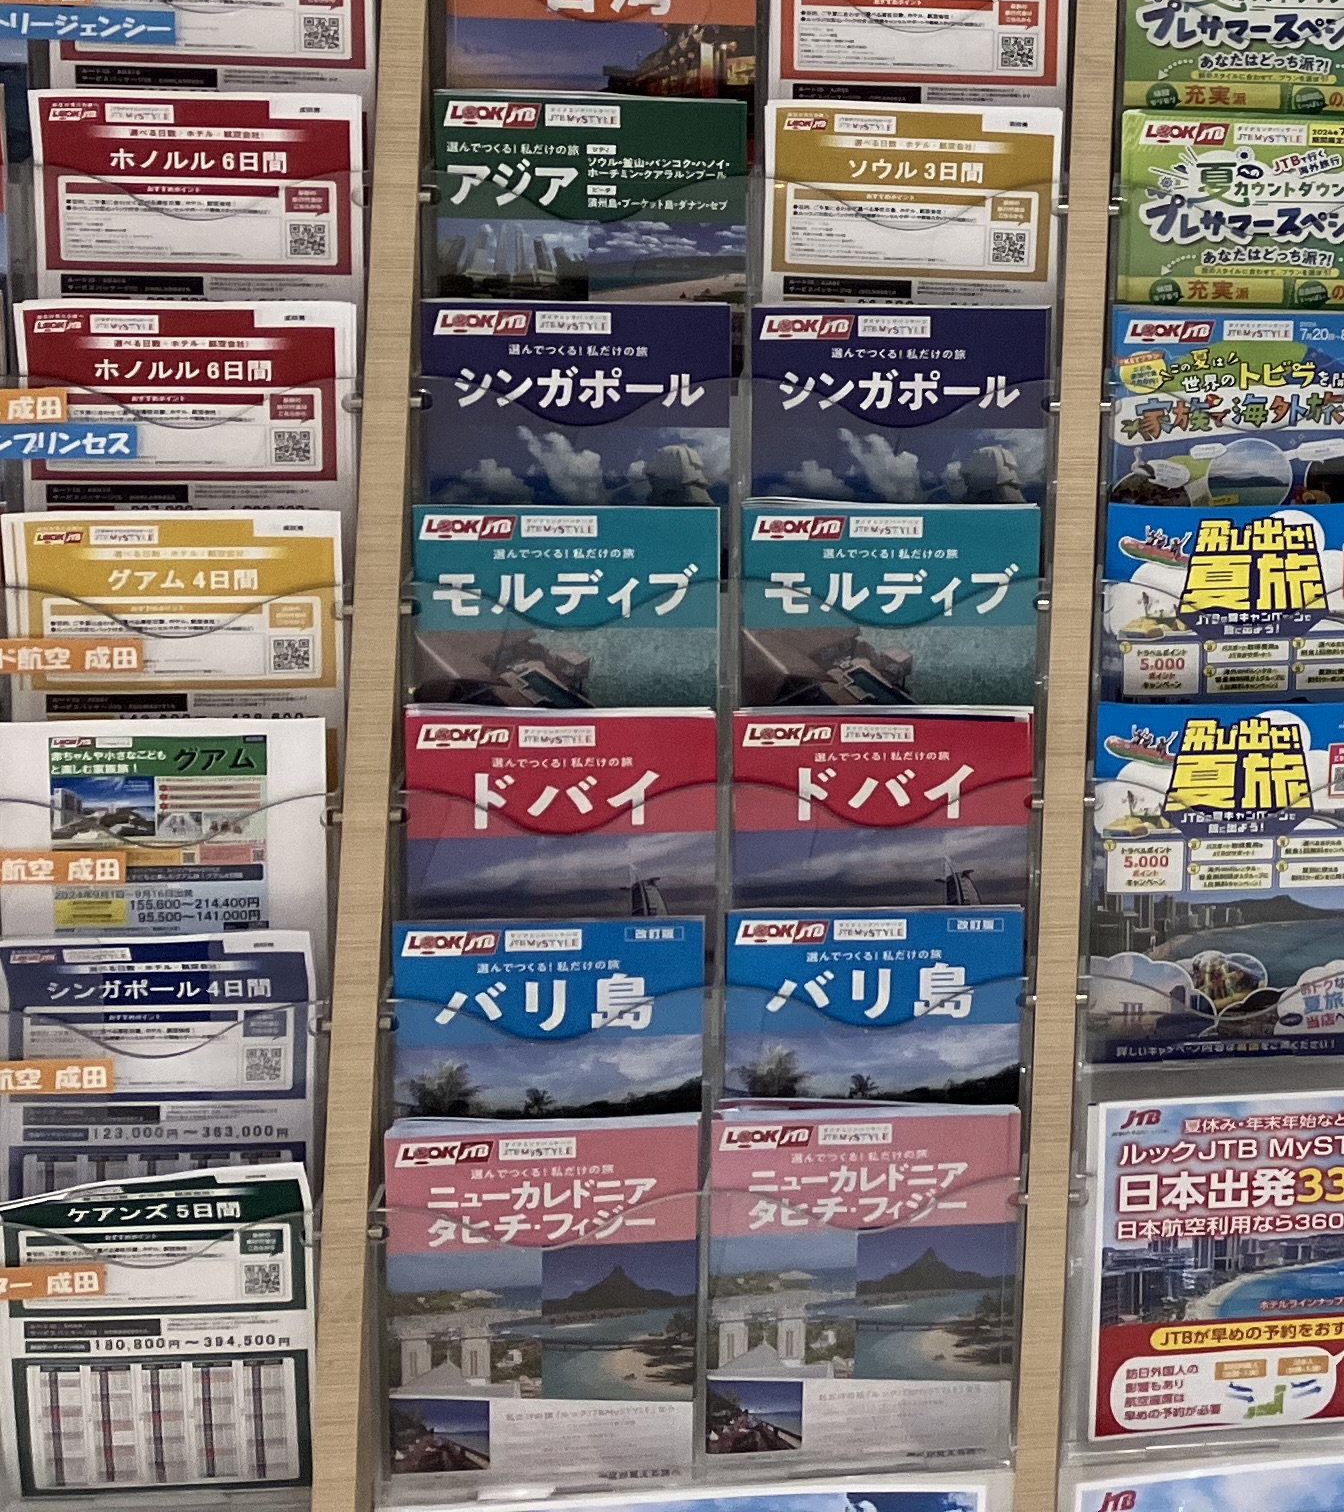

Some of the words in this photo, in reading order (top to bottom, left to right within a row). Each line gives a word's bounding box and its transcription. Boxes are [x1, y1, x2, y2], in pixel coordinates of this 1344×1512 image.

[110, 148, 216, 171] ホノルル
[222, 151, 288, 173] 6日間
[847, 158, 918, 182] ソウル
[924, 160, 984, 184] 3日間
[446, 163, 579, 207] アジア
[94, 359, 200, 380] ホノルル
[207, 360, 272, 382] 6日間
[454, 366, 706, 411] シンガポール
[8, 397, 61, 420] 成田
[778, 370, 1021, 413] シンガポール
[108, 569, 186, 591] グアム
[193, 568, 259, 590] 4日間
[432, 563, 699, 619] モルディブ
[765, 562, 1020, 617] モルディブ
[1182, 552, 1328, 614] 夏旅
[85, 646, 138, 670] 成田
[473, 768, 660, 831] ドバイ
[798, 763, 976, 822] ドバイ
[1163, 752, 1313, 812] 夏旅
[67, 859, 120, 881] 成田
[48, 979, 200, 1000] シンガポール
[207, 979, 271, 998] 4日間
[434, 974, 655, 1032] バリ島
[766, 963, 974, 1019] バリ島
[56, 1066, 107, 1088] 成田
[427, 1177, 658, 1209] ニューカレドニア
[748, 1161, 968, 1193] ニューカレドニア
[69, 1203, 167, 1222] ケアンズ
[177, 1202, 240, 1219] 5日間
[748, 1195, 968, 1231] タヒチ・フィジー
[427, 1212, 656, 1249] タヒチ・フィジー
